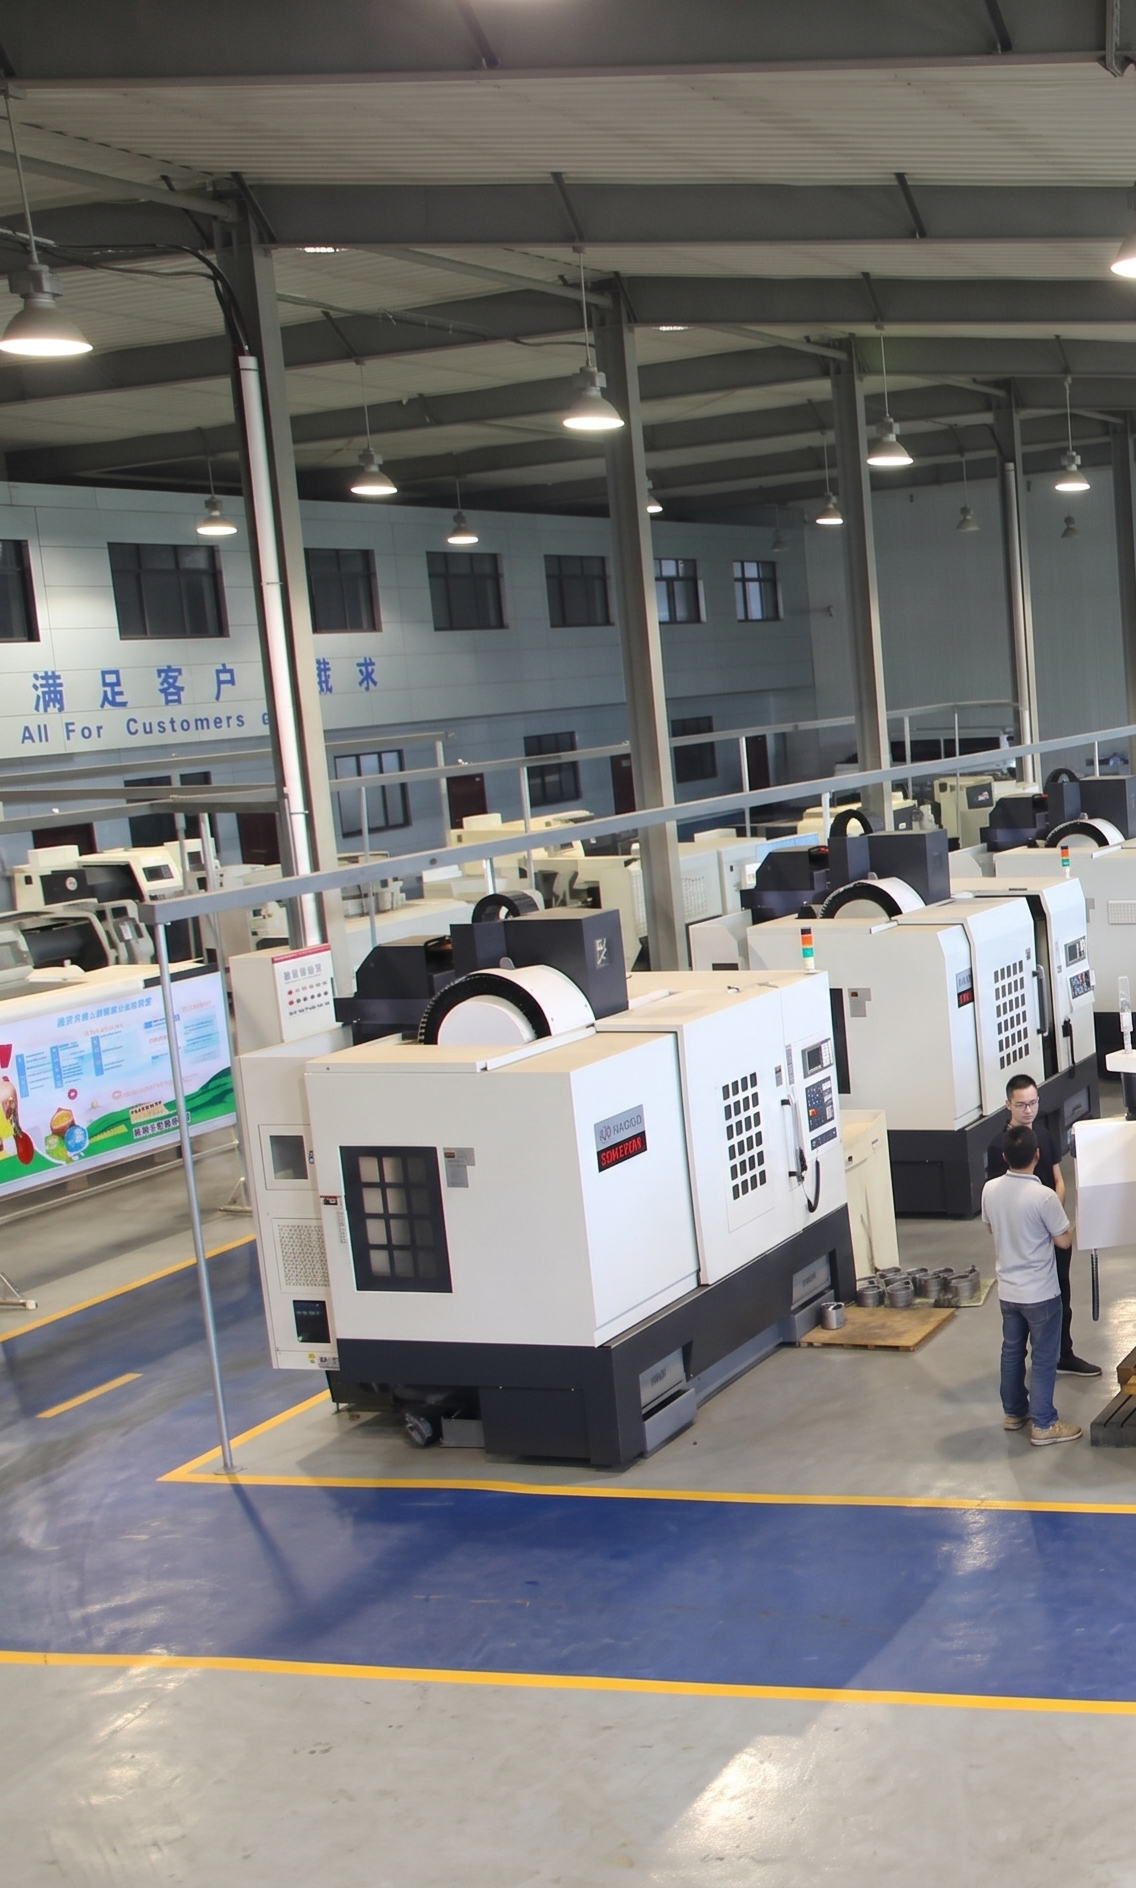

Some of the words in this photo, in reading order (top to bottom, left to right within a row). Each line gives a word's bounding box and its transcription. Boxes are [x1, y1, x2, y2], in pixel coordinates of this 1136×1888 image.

[21, 724, 49, 744] All
[64, 721, 104, 741] For
[126, 712, 245, 736] Customers
